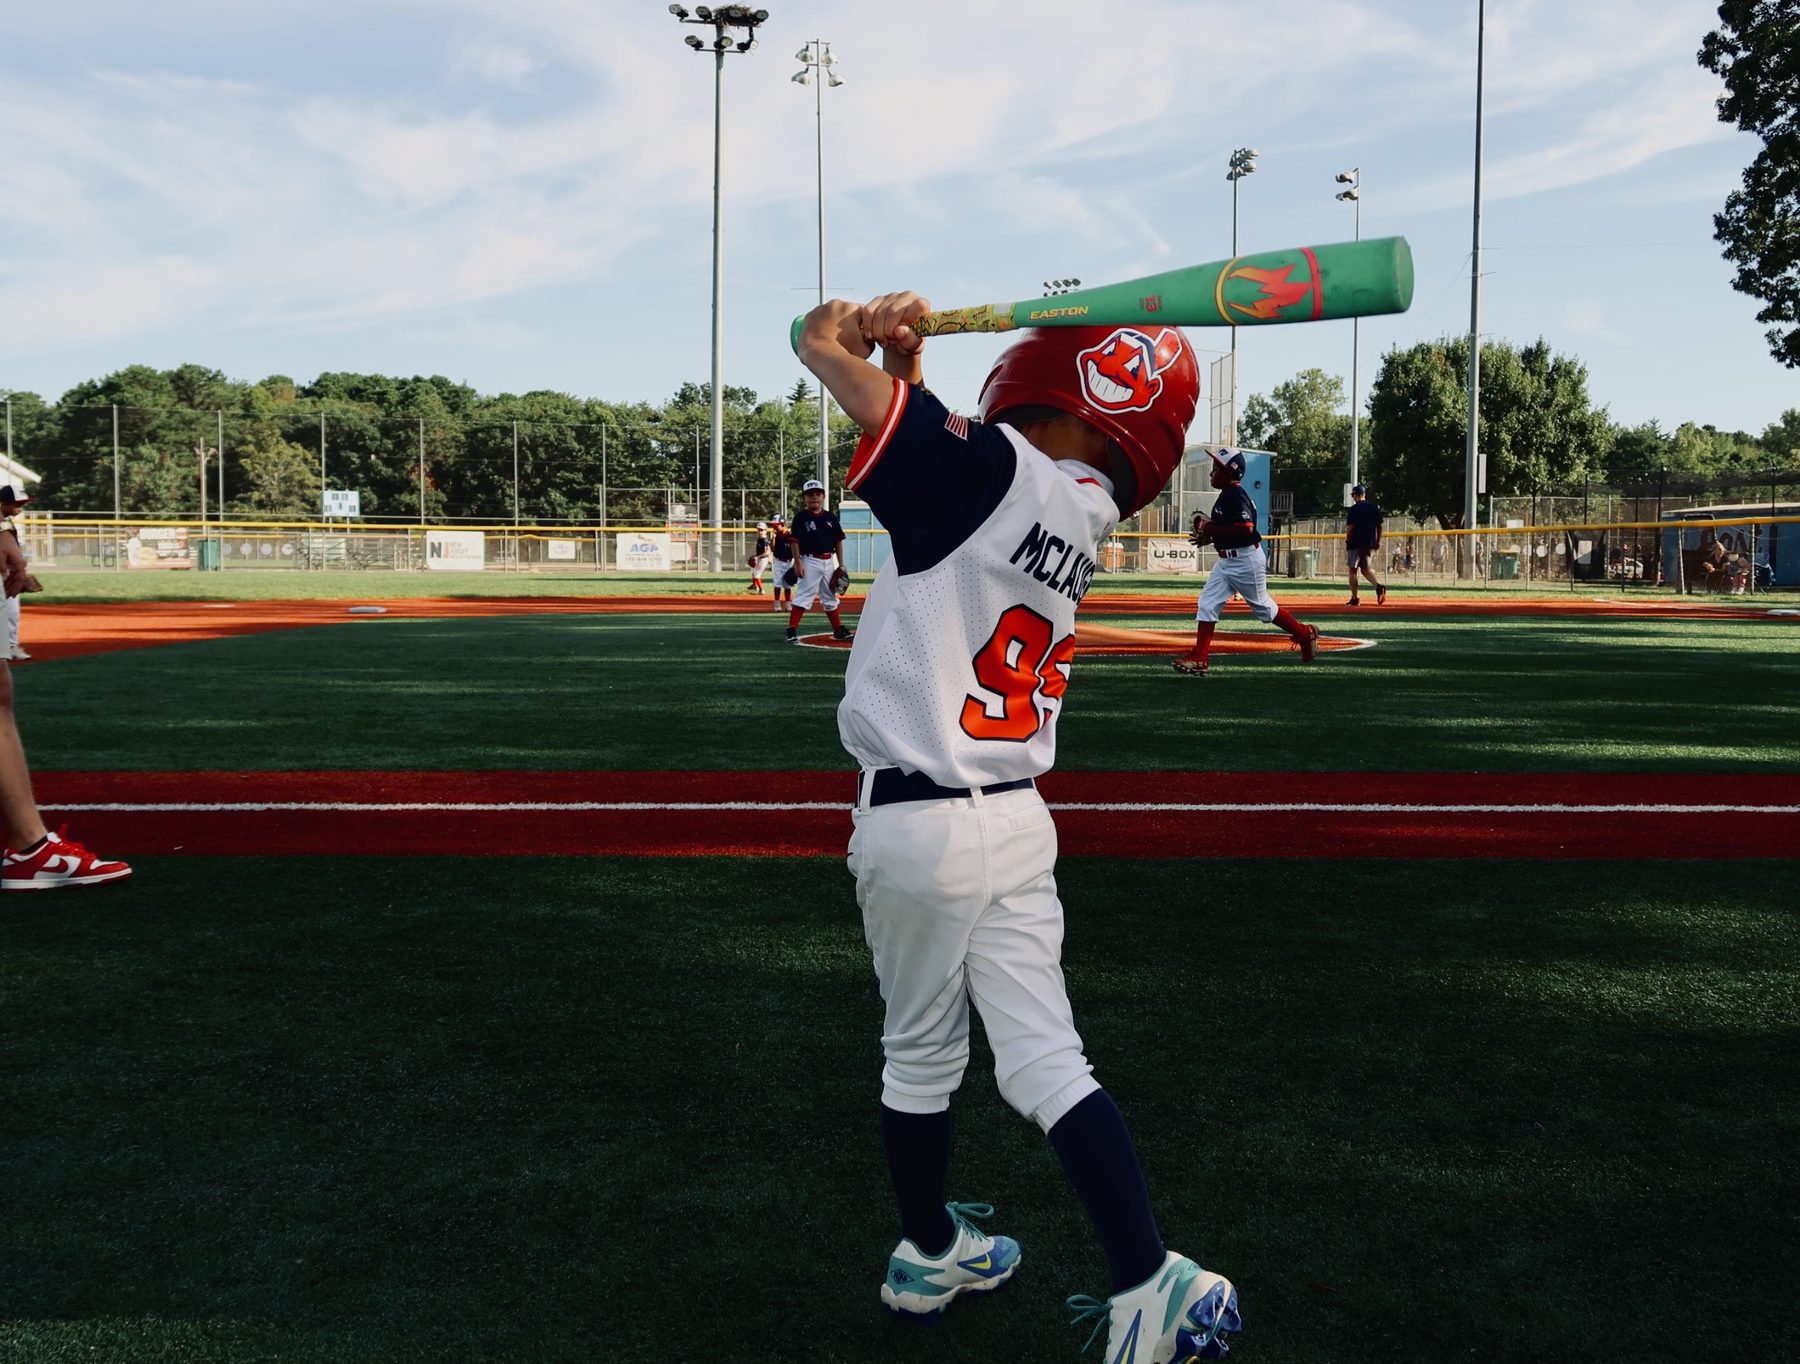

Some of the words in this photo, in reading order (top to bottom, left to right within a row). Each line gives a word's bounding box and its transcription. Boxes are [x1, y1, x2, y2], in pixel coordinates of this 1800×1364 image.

[1029, 305, 1089, 320] EASTON
[629, 543, 658, 553] AGP
[1154, 550, 1196, 559] U-BOX
